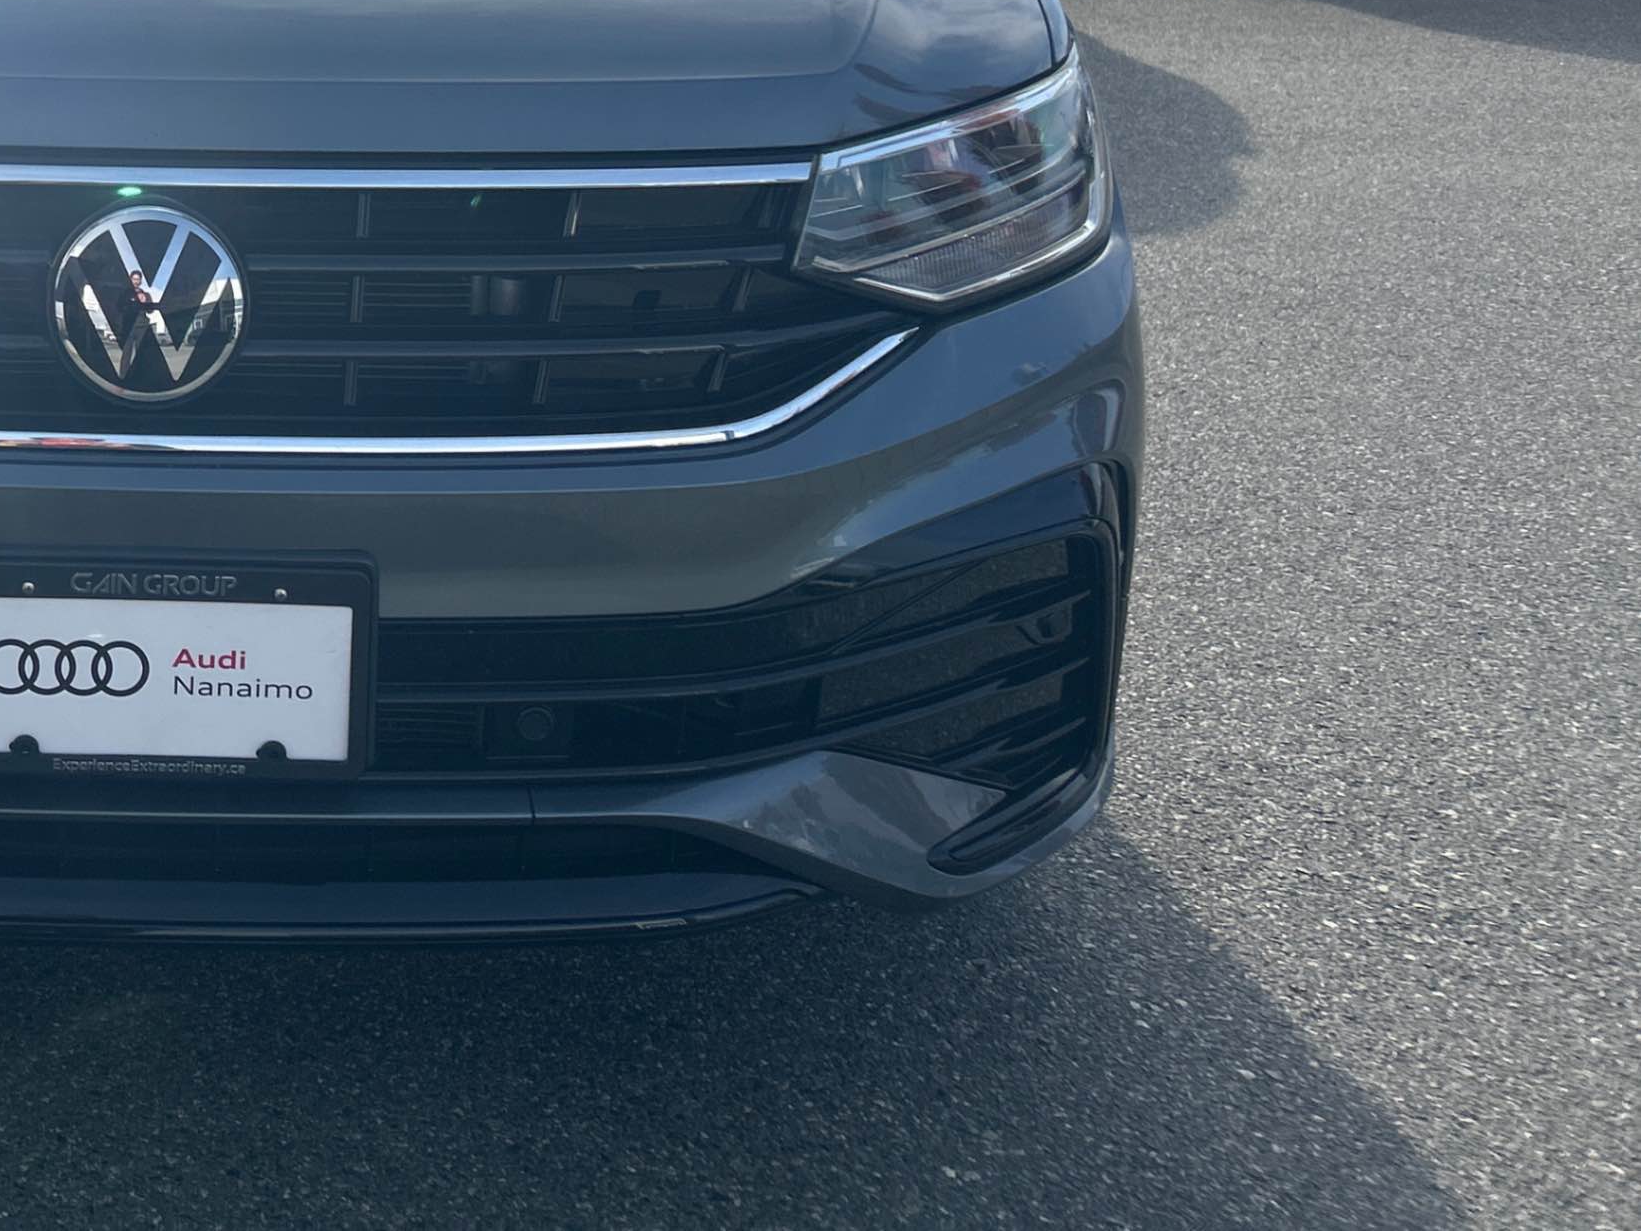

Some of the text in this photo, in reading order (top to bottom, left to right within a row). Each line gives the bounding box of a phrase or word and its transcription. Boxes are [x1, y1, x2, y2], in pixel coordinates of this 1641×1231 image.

[70, 572, 238, 596] GAIN GROUP
[172, 648, 246, 670] Audi
[174, 675, 313, 700] Nanaimo
